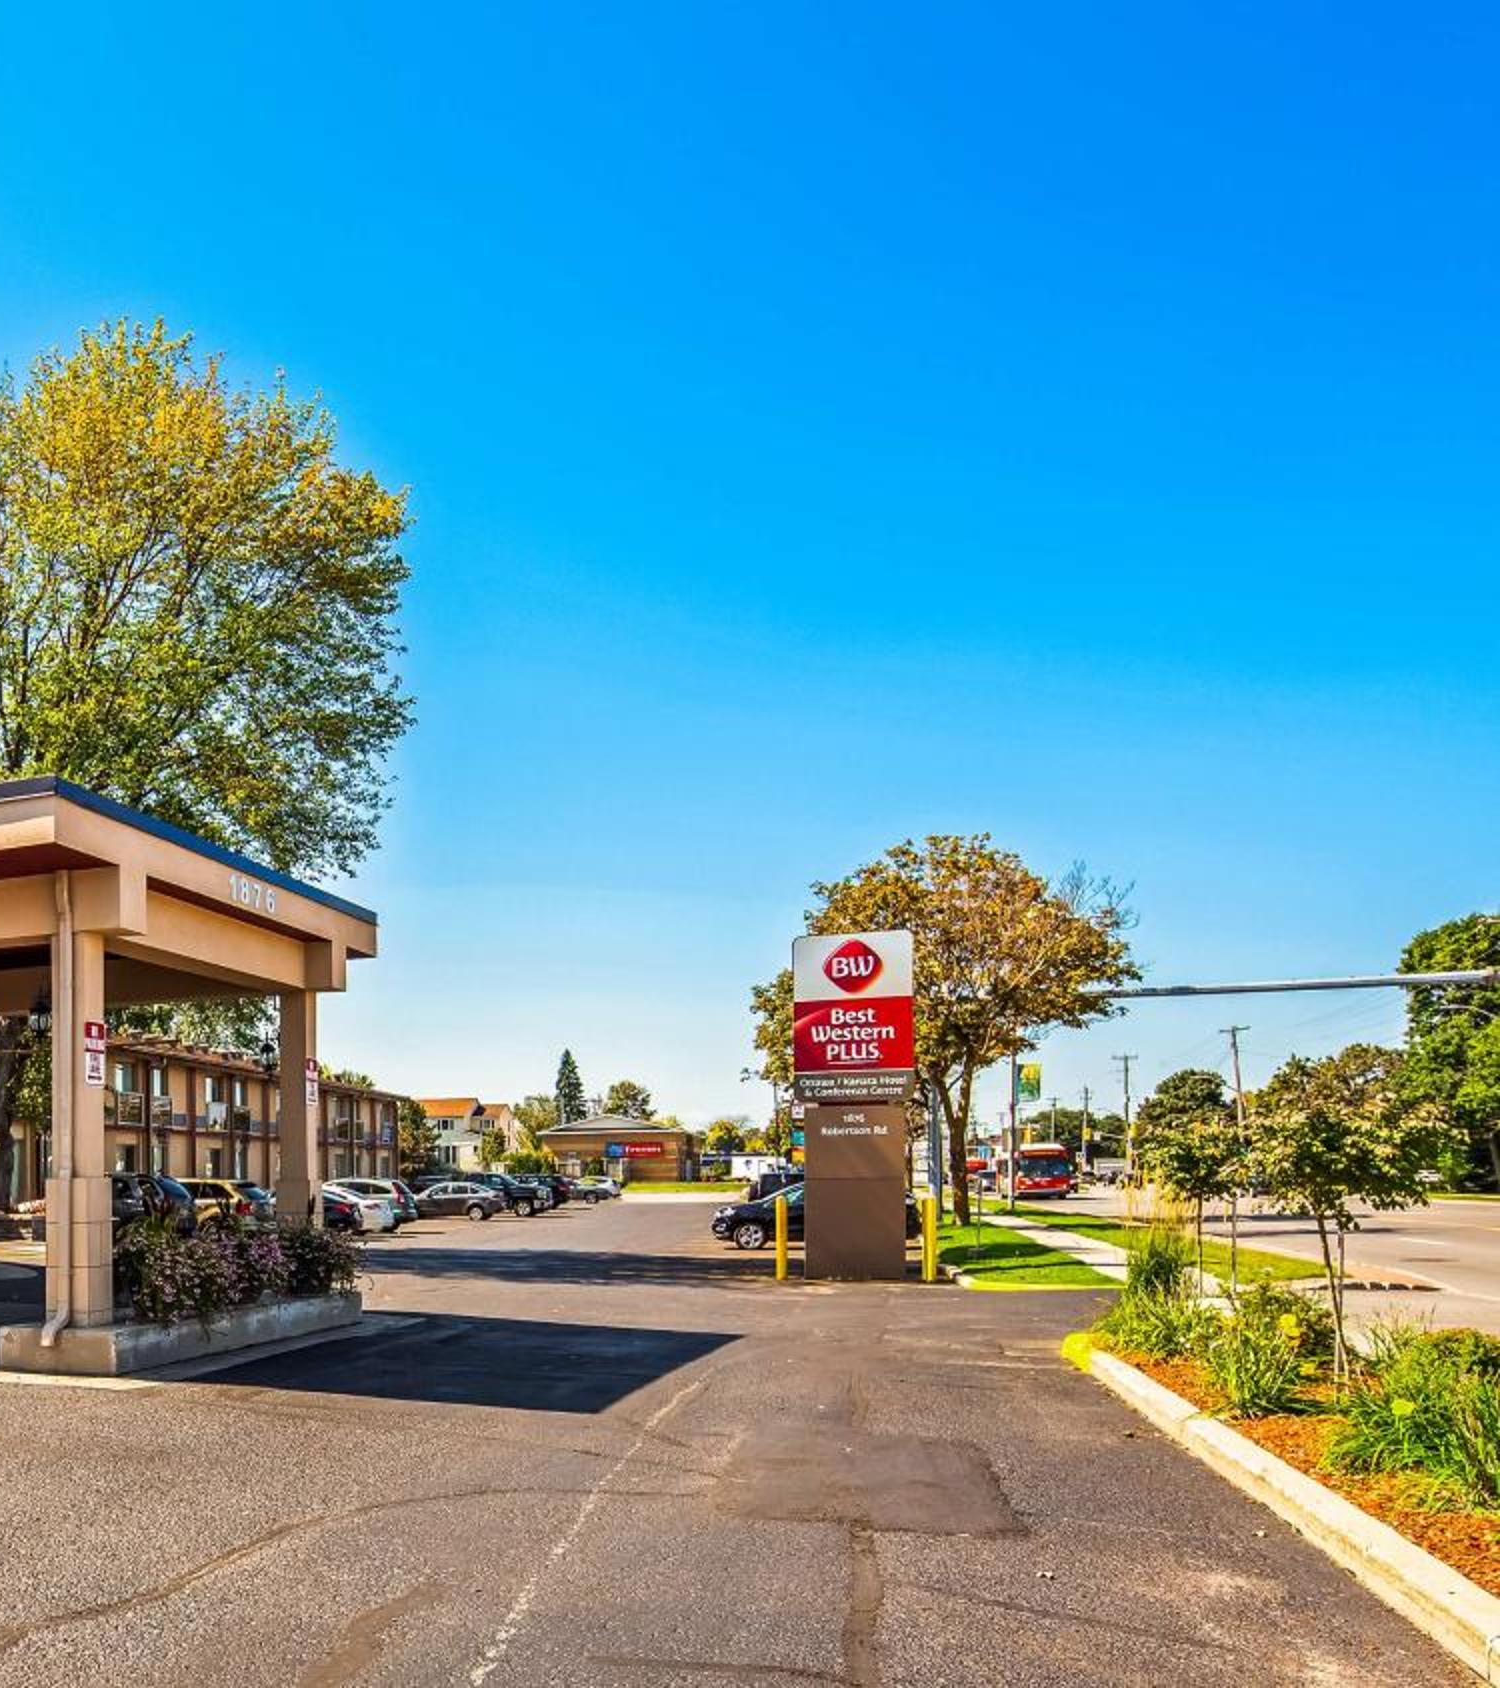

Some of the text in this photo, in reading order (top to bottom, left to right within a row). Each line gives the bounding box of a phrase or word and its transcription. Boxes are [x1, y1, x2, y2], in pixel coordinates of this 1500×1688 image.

[229, 874, 275, 913] 1876
[831, 955, 874, 978] BW
[831, 1007, 876, 1025] Best
[811, 1024, 895, 1043] Western
[880, 1075, 907, 1085] Hotel
[814, 1085, 868, 1097] Conference
[869, 1085, 903, 1096] Centre
[821, 1126, 871, 1137] Robertson
